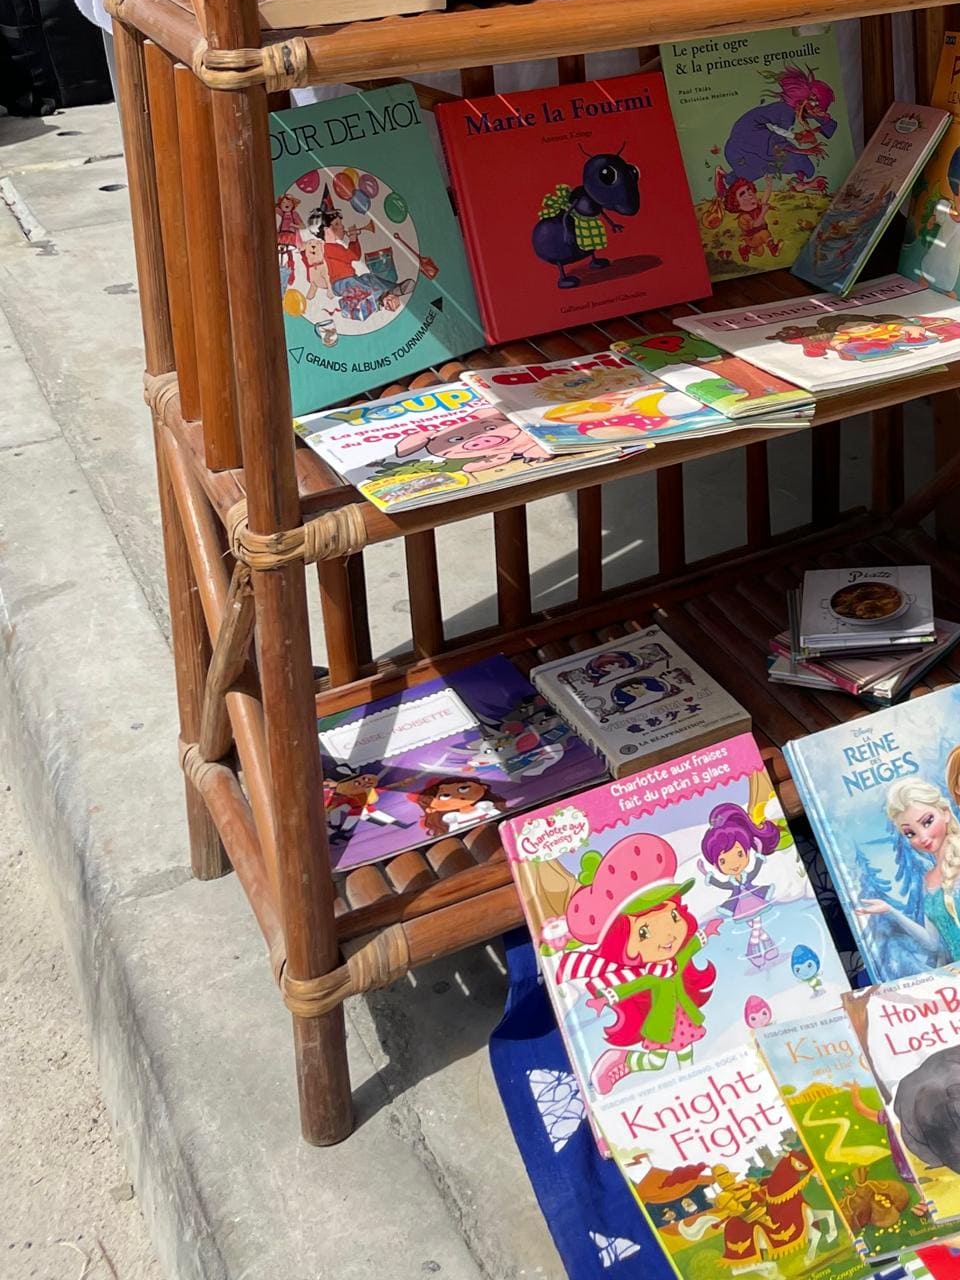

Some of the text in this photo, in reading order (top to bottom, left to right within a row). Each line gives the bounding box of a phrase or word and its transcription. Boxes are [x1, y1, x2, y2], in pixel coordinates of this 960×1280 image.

[672, 37, 749, 59] Le petit ogre
[675, 42, 822, 76] & la princesse grenouille
[323, 99, 422, 147] DE MOI
[464, 87, 655, 137] Marie la Fourmi
[305, 308, 438, 373] GRANDS ALBUMS TOURNIMAGE
[842, 731, 900, 767] REINE
[610, 767, 669, 798] Charlotte
[669, 760, 691, 776] aux
[618, 762, 731, 812] fait du patin à glace
[841, 751, 920, 798] NEIGES
[521, 824, 568, 855] Charlotte
[902, 975, 935, 990] READING
[880, 998, 940, 1028] How
[784, 1036, 854, 1064] King
[885, 1022, 948, 1056] Lost
[621, 1070, 763, 1140] Knight
[670, 1102, 783, 1162] Fight
